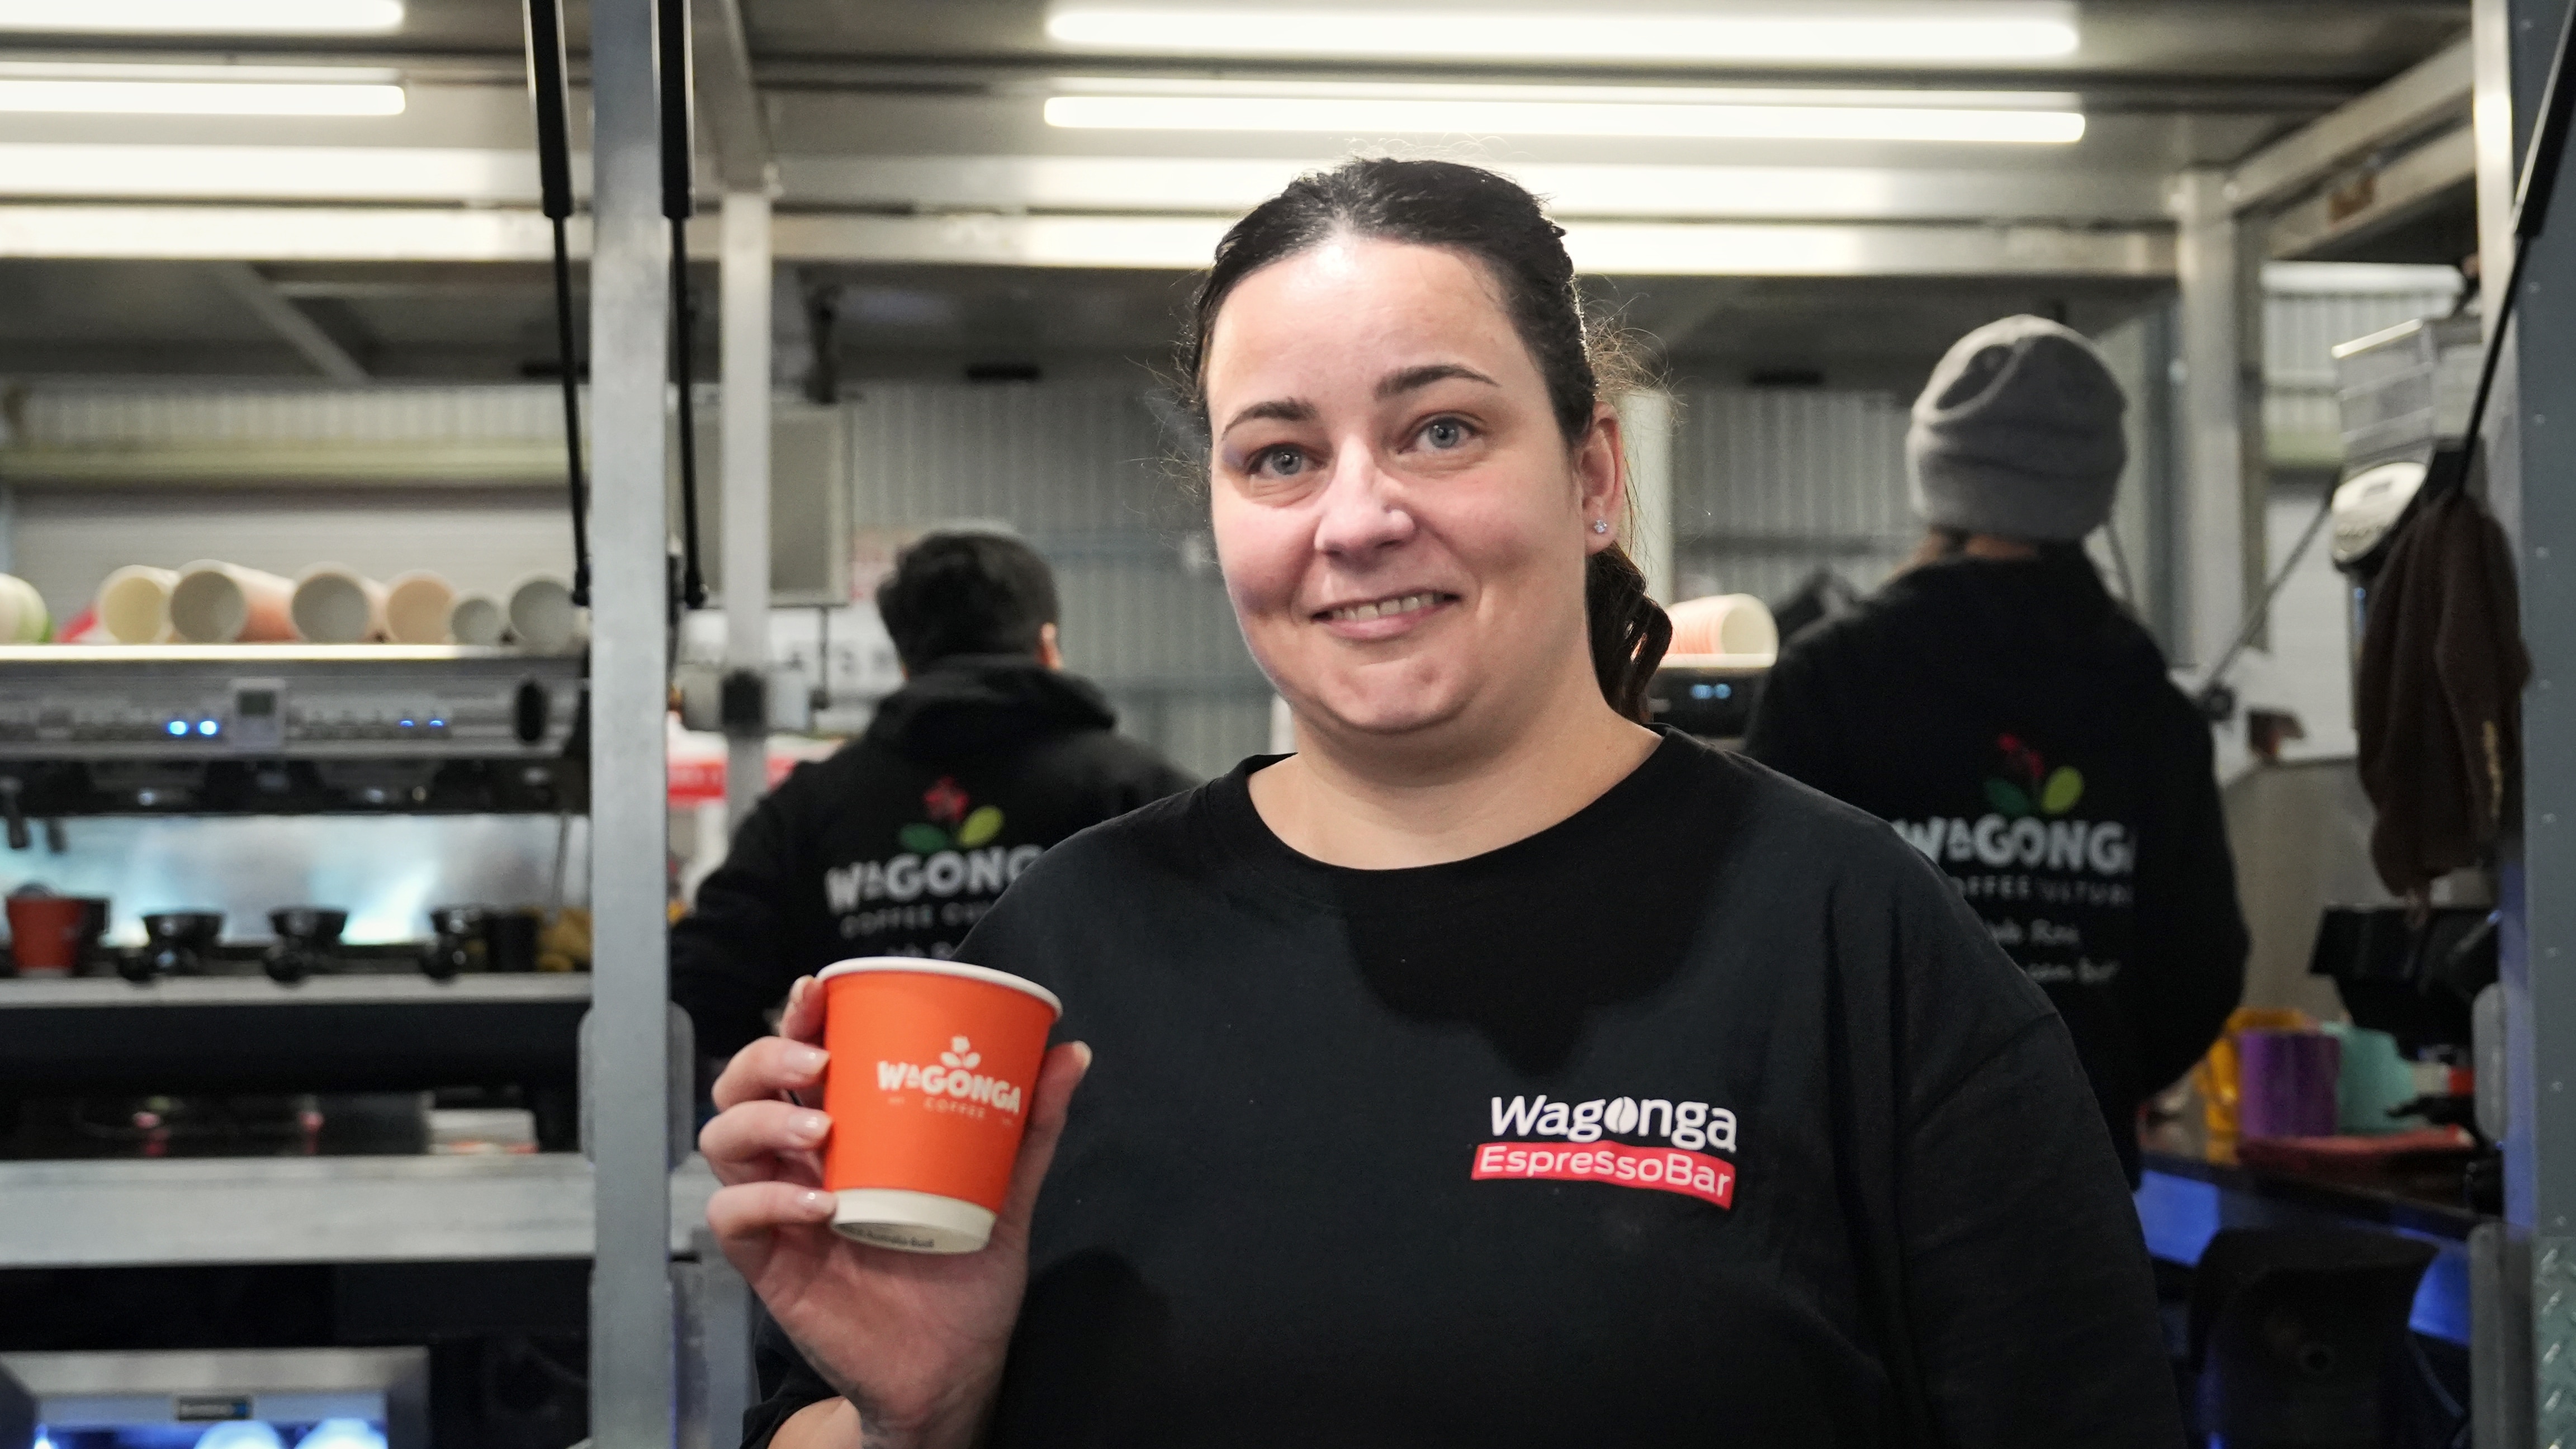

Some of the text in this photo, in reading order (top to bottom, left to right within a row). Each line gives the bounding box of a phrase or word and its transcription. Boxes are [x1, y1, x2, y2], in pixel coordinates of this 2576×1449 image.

[1891, 814, 2137, 874] WAGONG
[825, 844, 1044, 913] WAGONG
[1951, 875, 2030, 898] OFFEE
[877, 1061, 1021, 1114] WAGONGA
[924, 1096, 985, 1118] COFFEE
[1491, 1095, 1736, 1153] Wagonga
[1480, 1146, 1731, 1197] EspressoBar
